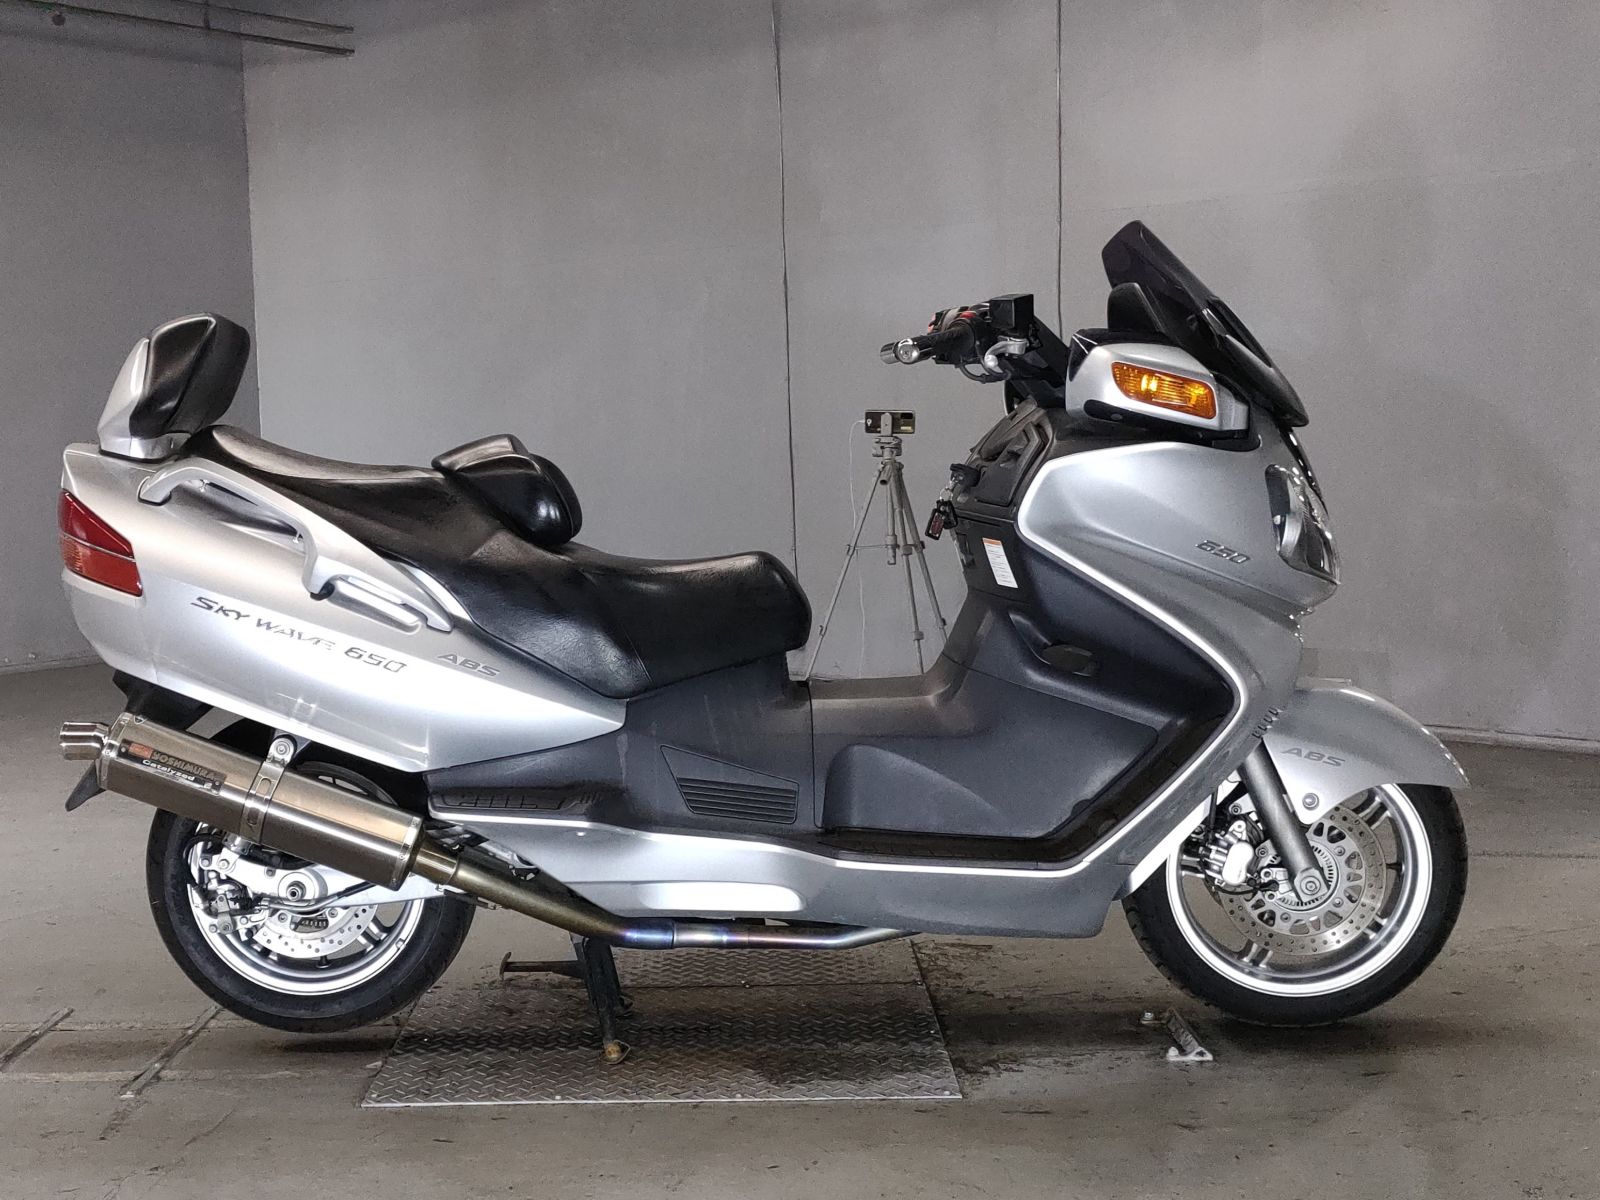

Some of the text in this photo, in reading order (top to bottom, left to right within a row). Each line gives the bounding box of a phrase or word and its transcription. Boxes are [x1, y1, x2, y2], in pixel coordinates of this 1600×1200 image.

[1195, 540, 1250, 563] 650
[190, 596, 407, 672] SKY WAVE 650
[437, 653, 500, 677] ABS
[151, 752, 215, 781] YOSHIMURA
[1281, 747, 1345, 767] ABS
